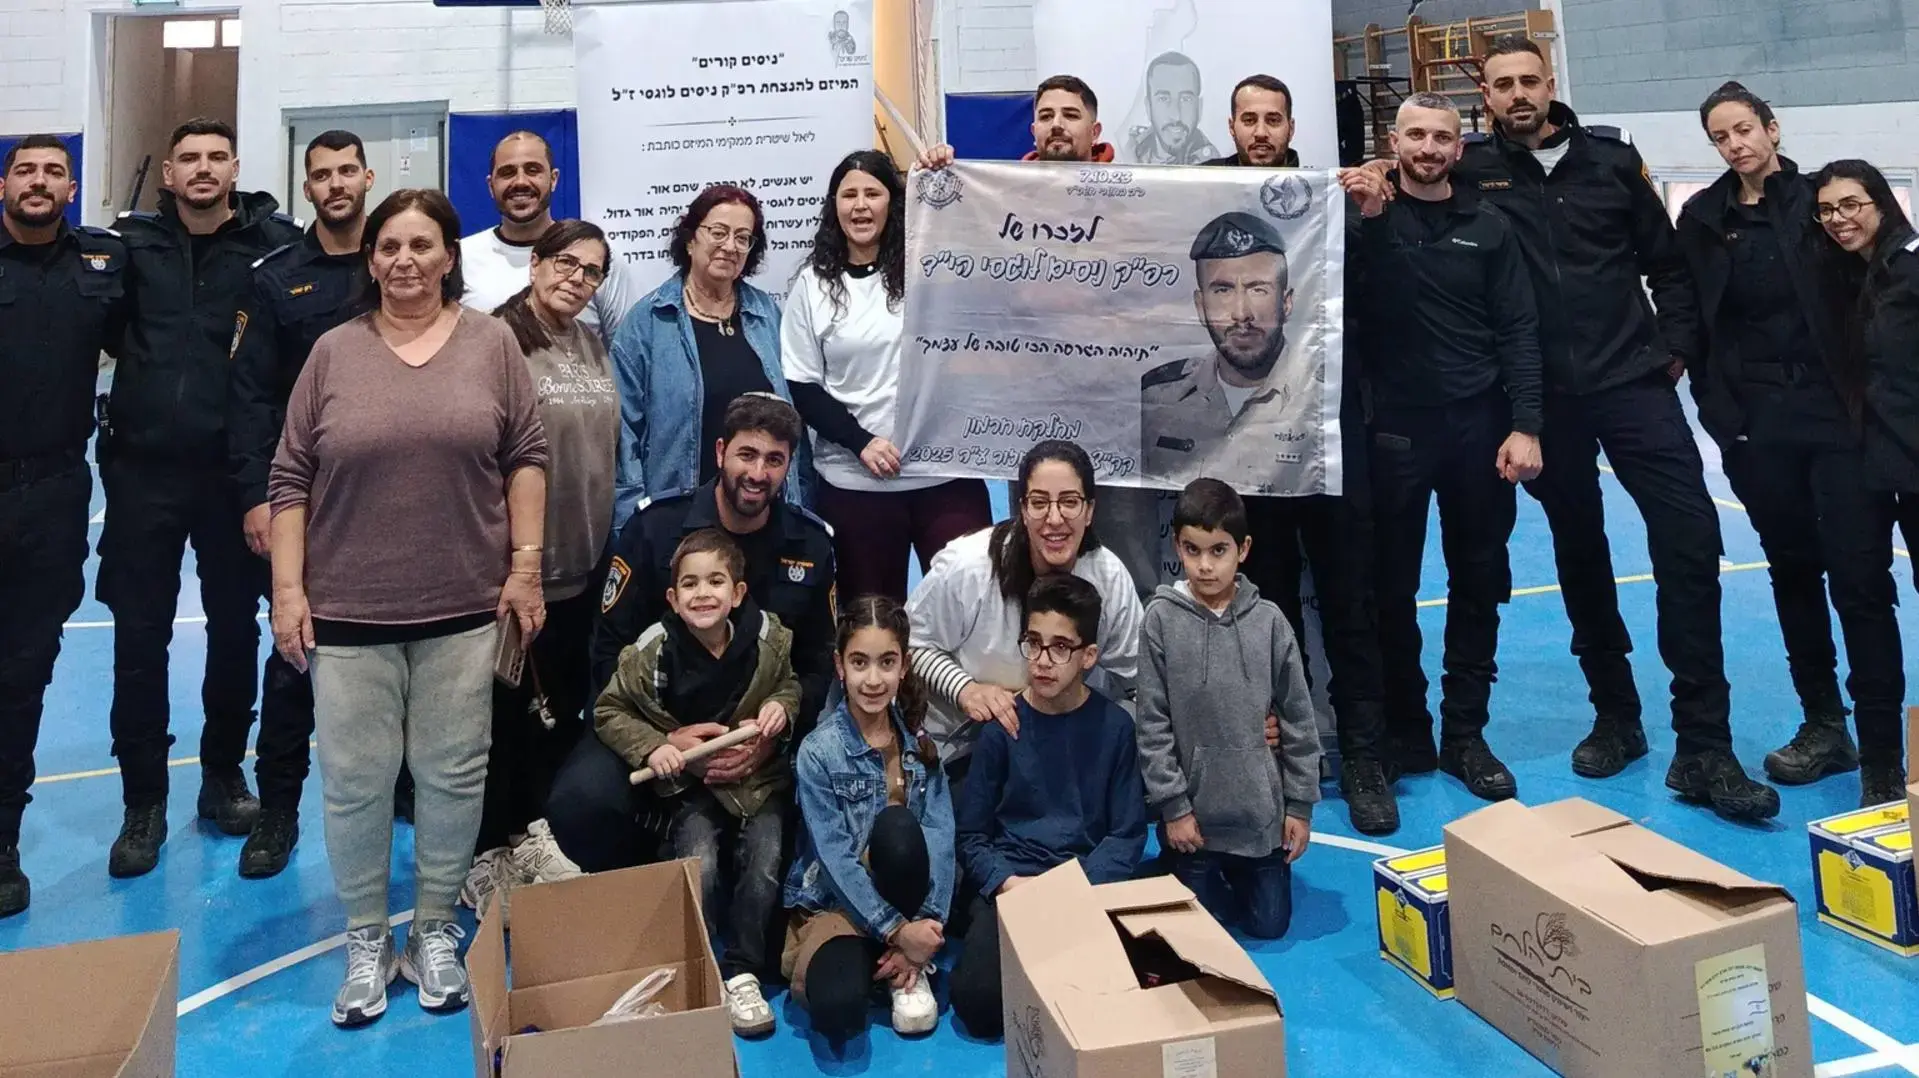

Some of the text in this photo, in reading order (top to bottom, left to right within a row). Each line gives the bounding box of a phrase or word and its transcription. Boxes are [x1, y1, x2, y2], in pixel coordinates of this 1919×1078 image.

[692, 52, 785, 69] "ניסים קורים"
[680, 85, 717, 98] ניסים
[760, 77, 814, 94] להנצחת
[818, 78, 859, 91] המיזם
[611, 87, 635, 101] ז"ל
[639, 84, 676, 100] לוגסי
[792, 130, 815, 143] ליאל
[682, 138, 713, 150] המיזם
[740, 177, 756, 188] לא
[758, 176, 797, 189] אנשים,
[799, 175, 813, 185] יש
[1079, 169, 1134, 185] 7.10.23
[672, 183, 700, 194] שהם
[766, 196, 794, 208] לוגסי
[634, 207, 654, 217] אור
[659, 204, 683, 216] יהיה
[765, 219, 804, 230] עשרות
[998, 212, 1105, 243] לזכרו של
[607, 228, 655, 242] הפקודים
[770, 239, 788, 250] וכל
[623, 250, 655, 264] בדרך
[980, 246, 1048, 282] לוגסי
[1046, 255, 1107, 287] ניסים
[963, 332, 981, 352] של
[984, 337, 1021, 354] טובה
[1025, 341, 1050, 354] הכי
[1053, 342, 1104, 357] הגרסה
[962, 411, 1082, 442] מחלקת חרמון
[909, 445, 955, 464] 2025
